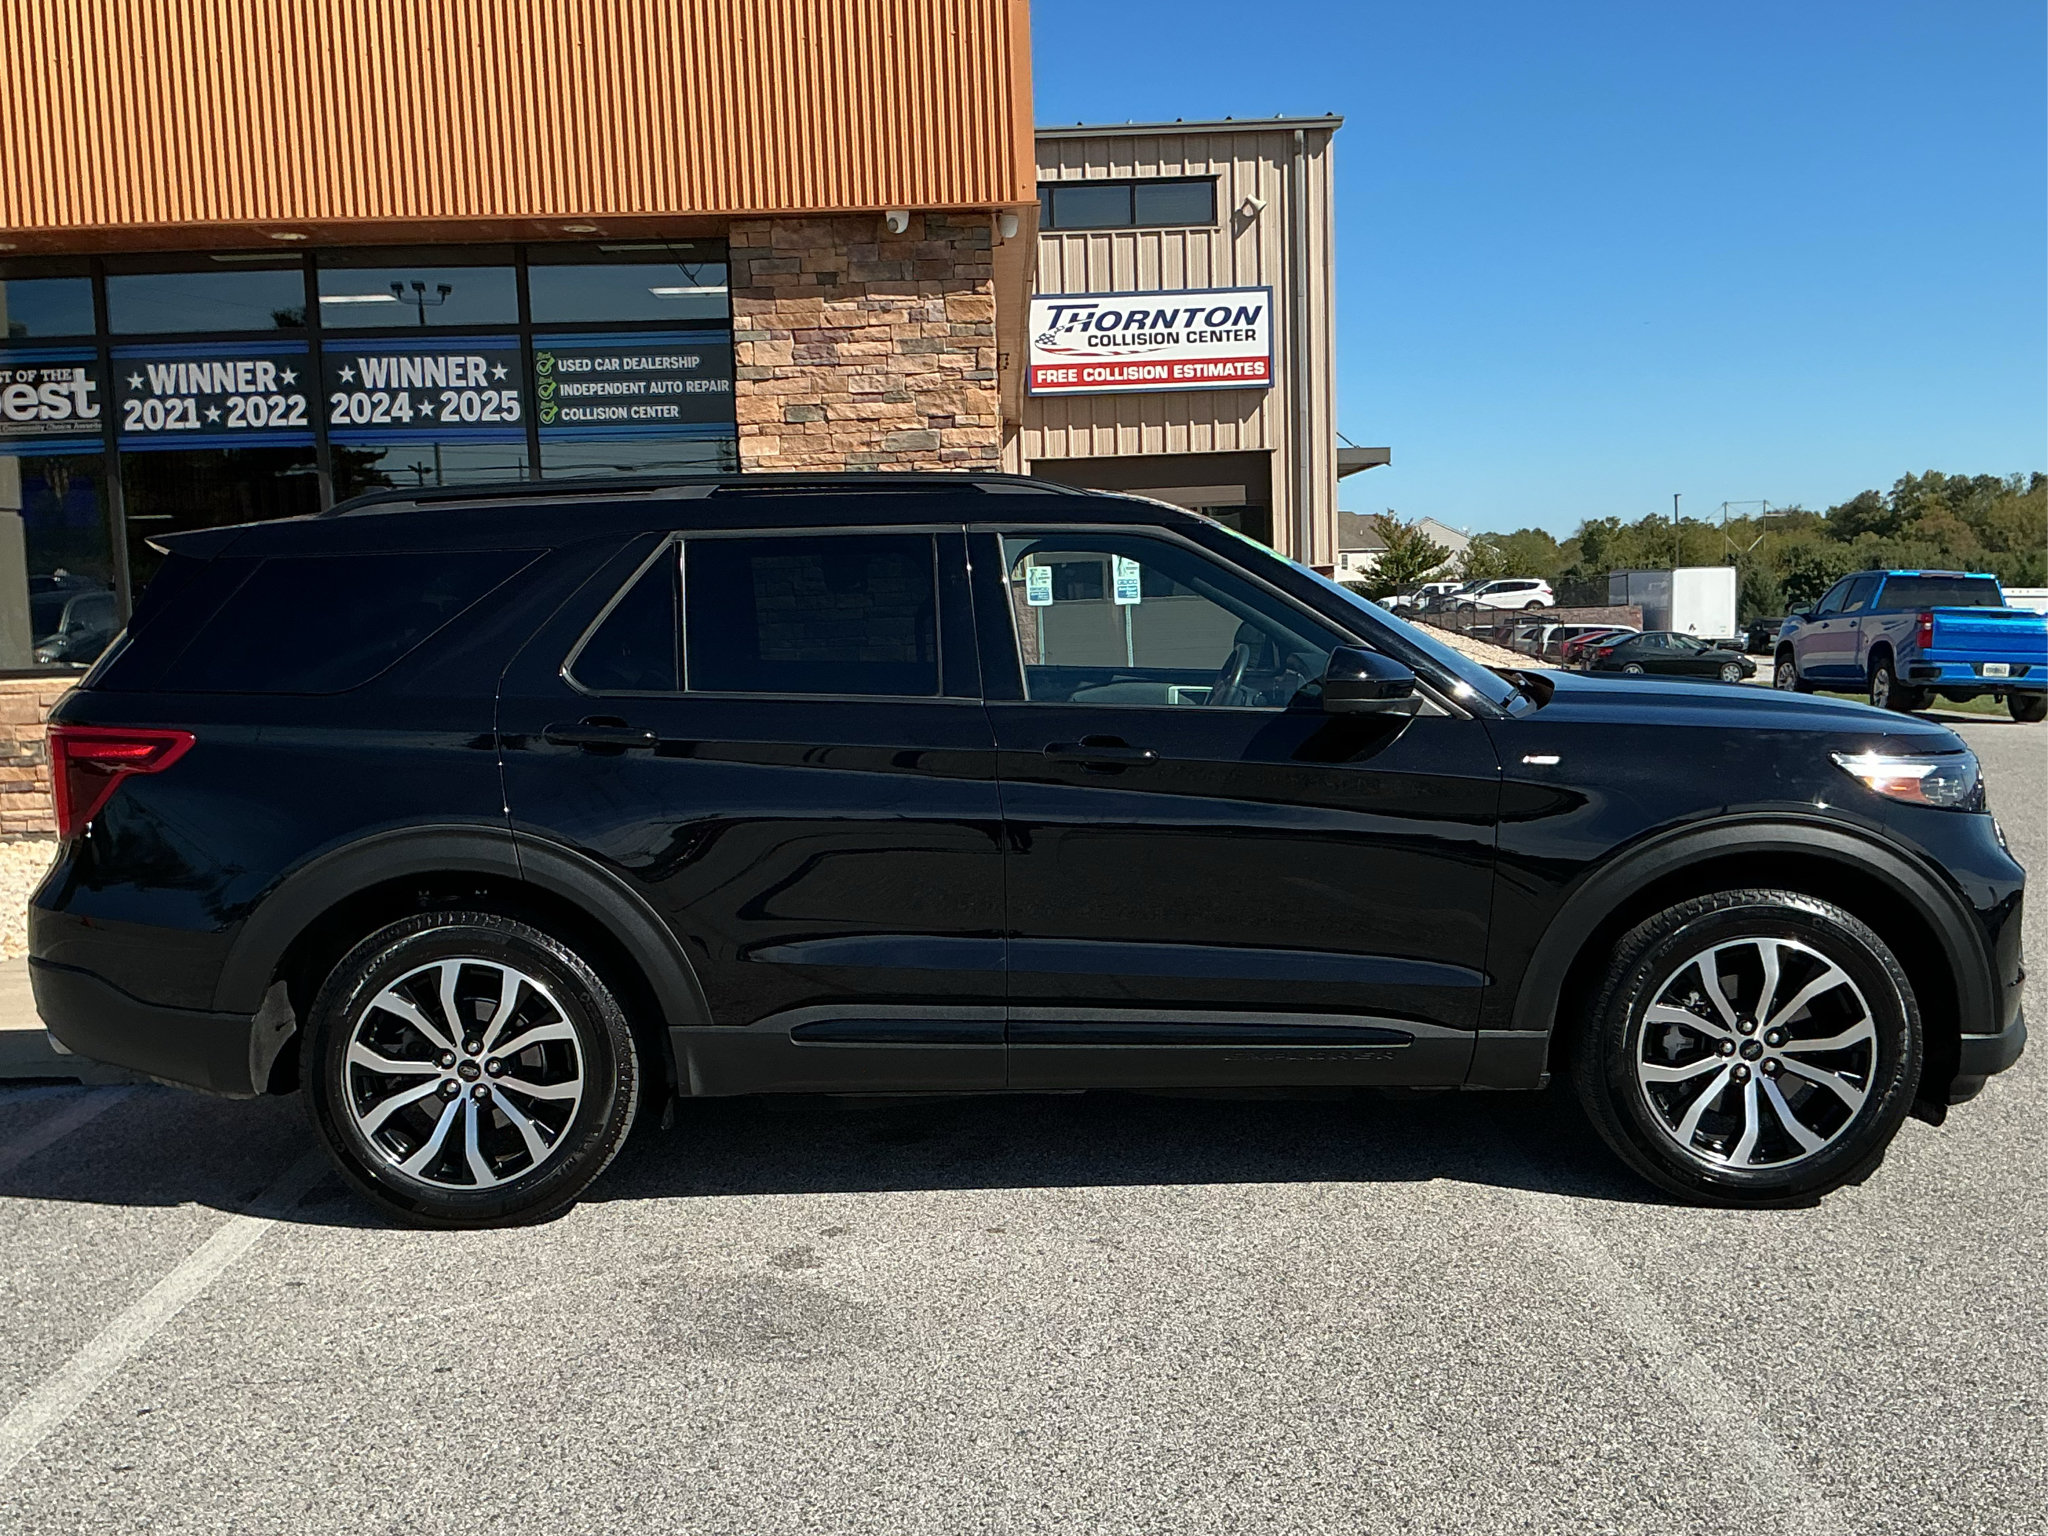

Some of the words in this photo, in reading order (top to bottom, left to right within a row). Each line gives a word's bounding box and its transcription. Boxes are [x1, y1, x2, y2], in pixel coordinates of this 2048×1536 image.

[1047, 304, 1263, 333] THORNTON
[1087, 332, 1180, 348] COLLISION
[1186, 329, 1257, 343] CENTER
[16, 370, 37, 382] OF
[40, 368, 72, 381] THE
[357, 356, 488, 389] WINNER
[557, 359, 592, 372] USED
[594, 358, 620, 371] CAR
[623, 356, 700, 370] DEALERSHIP
[1037, 369, 1078, 384] FREE
[1083, 365, 1168, 382] COLLISION
[1174, 362, 1265, 378] ESTIMATES
[147, 361, 278, 396] WINNER
[560, 381, 647, 397] INDEPENDENT
[649, 381, 683, 394] AUTO
[686, 379, 730, 393] REPAIR
[123, 398, 201, 431] 2021
[226, 395, 308, 428] 2022
[330, 391, 414, 424] 2024
[440, 390, 521, 422] 2025
[561, 406, 628, 421] COLLISION
[631, 405, 679, 418] CENTER
